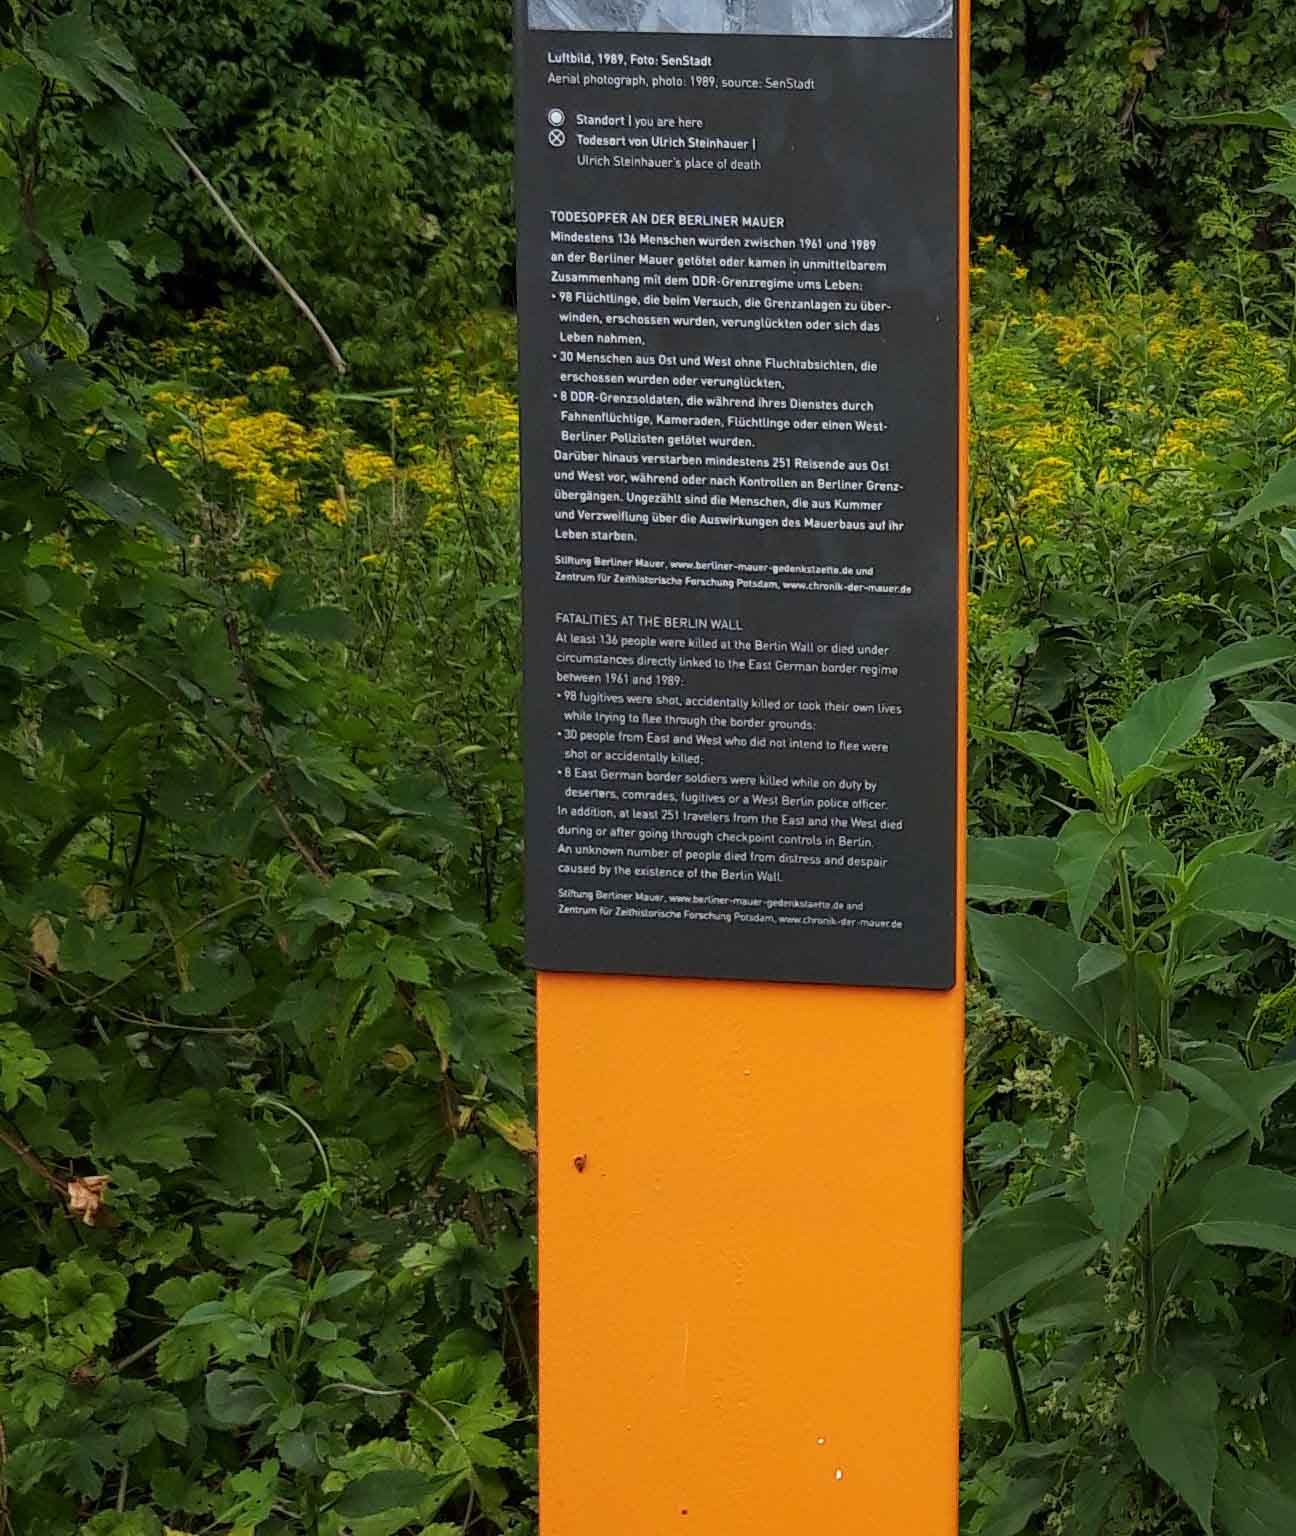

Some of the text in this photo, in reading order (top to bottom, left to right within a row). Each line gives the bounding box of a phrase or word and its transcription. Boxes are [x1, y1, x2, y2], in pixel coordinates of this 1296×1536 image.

[661, 54, 711, 65] SenStadt
[547, 72, 580, 83] Aerial
[765, 77, 814, 88] SenStadt
[576, 114, 624, 125] Standort
[634, 118, 653, 128] you
[656, 118, 674, 126] are
[678, 117, 702, 127] here
[576, 134, 626, 145] Todesort
[651, 136, 685, 147] Ulrich
[688, 137, 748, 148] Steinhauer
[576, 155, 761, 170] Ulrich Steinhauer's place of death
[550, 211, 784, 227] TODESOPFER AN DER BERLINER MAUER
[550, 231, 876, 249] Mindestens 136 Menschen wurden zwischen 1961 und 1989
[550, 252, 886, 270] an der Berliner Mauer getötet oder kamen in unmittelbarem
[551, 271, 640, 285] Zusammenhang
[643, 274, 660, 284] mit
[664, 276, 688, 285] dem
[691, 275, 794, 290] DDR-Grenzregime
[797, 281, 821, 289] ums
[555, 613, 742, 630] FATALITIES AT THE BERLIN WALL
[555, 632, 567, 642] At
[570, 634, 596, 643] least
[600, 634, 618, 644] 136
[620, 636, 656, 648] people
[659, 639, 685, 647] were
[688, 638, 717, 648] killed
[720, 640, 730, 649] at
[734, 640, 751, 649] the
[754, 640, 787, 651] Berlin
[790, 642, 813, 651] Wall
[831, 643, 854, 653] died
[857, 644, 889, 655] under
